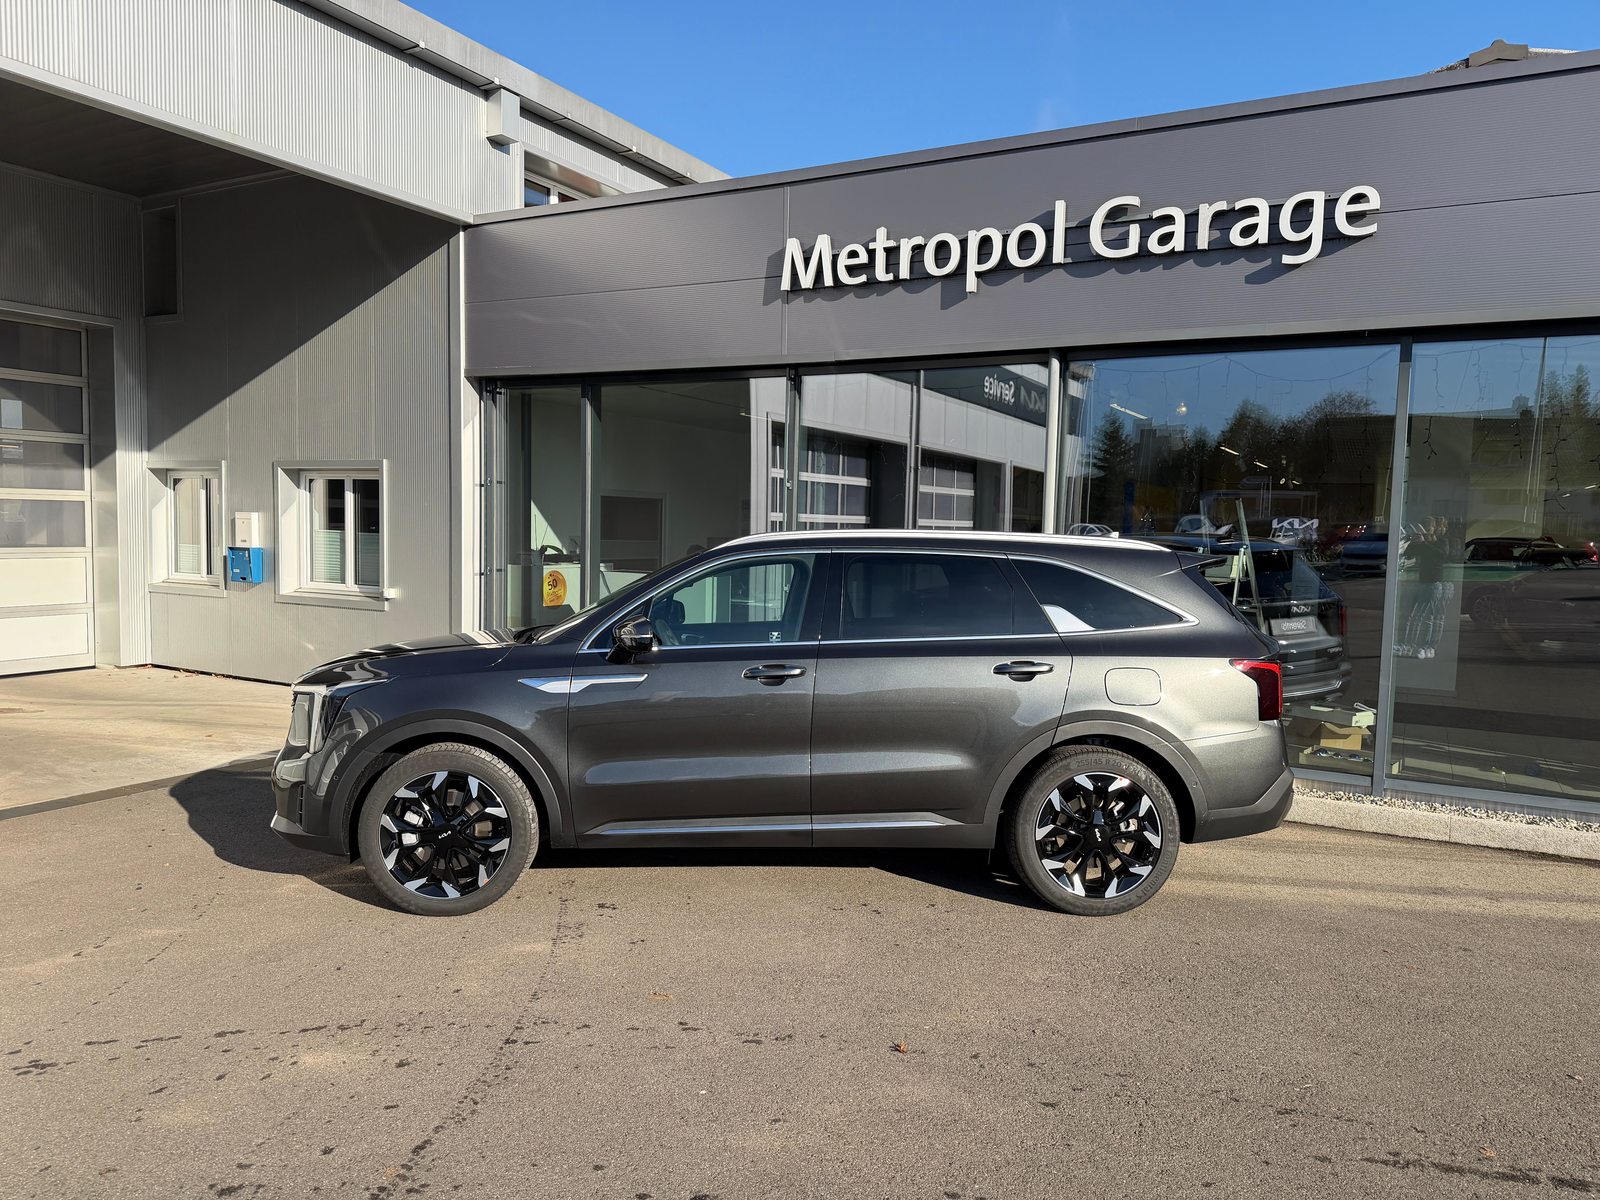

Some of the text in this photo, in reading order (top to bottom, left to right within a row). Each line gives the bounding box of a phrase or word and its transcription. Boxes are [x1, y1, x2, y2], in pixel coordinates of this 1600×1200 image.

[780, 184, 1381, 293] Metropol Garage
[548, 578, 558, 590] 50
[1076, 759, 1102, 768] 255/45
